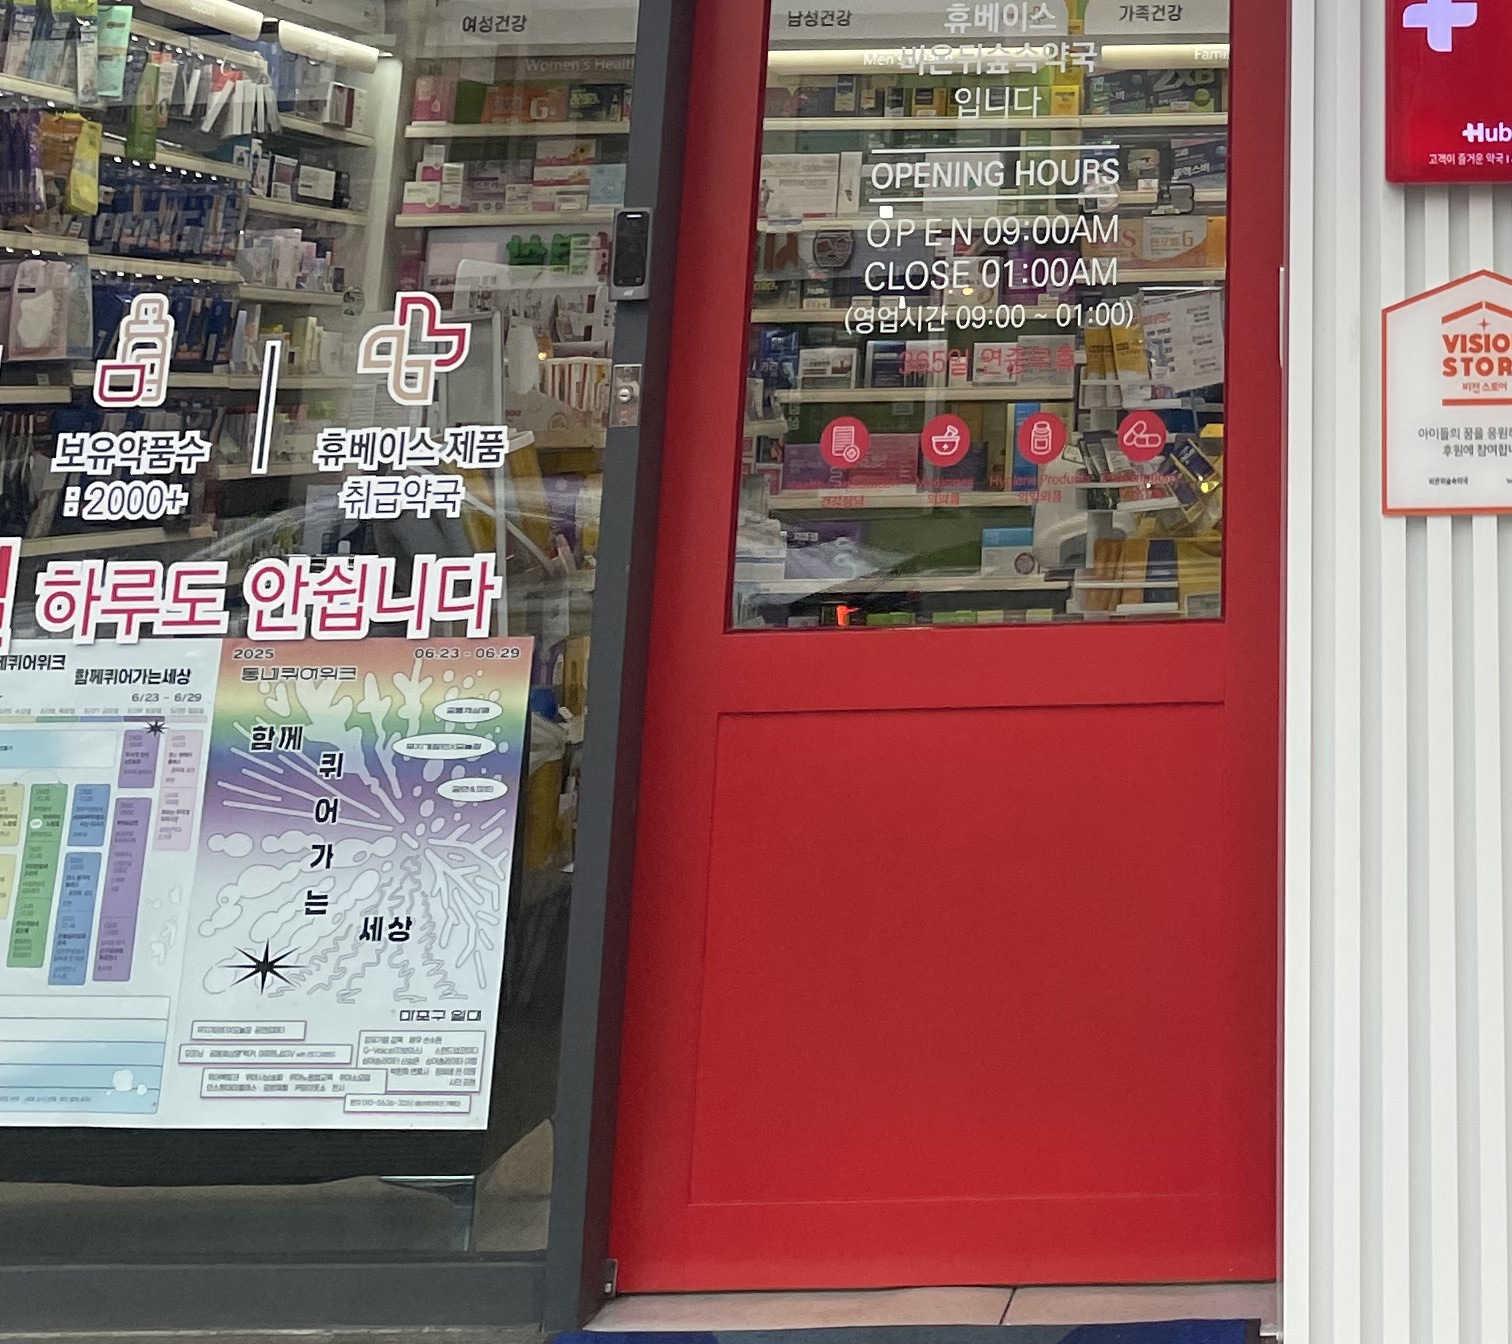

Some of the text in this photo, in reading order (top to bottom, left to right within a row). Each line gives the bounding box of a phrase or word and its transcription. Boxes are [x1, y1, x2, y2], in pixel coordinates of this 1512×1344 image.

[462, 15, 527, 33] 여성건강
[787, 10, 853, 27] 남성건강
[944, 2, 1057, 34] 휴베이스
[1119, 4, 1183, 23] 가족건강
[900, 41, 1098, 76] 비온뒤숲속약국
[954, 86, 1042, 120] 입니다
[871, 158, 1120, 190] OPENING HOURS
[866, 214, 1118, 248] OPEN 09:00AM
[864, 257, 1118, 291] CLOSE 01:00AM
[844, 305, 948, 334] (영업시간
[956, 305, 1025, 330] 09:00
[1056, 301, 1134, 329] 01:00)
[318, 429, 505, 466] 휴베이스 제품
[1418, 427, 1461, 440] 아이들의
[54, 433, 210, 472] 보유약품수
[1443, 444, 1474, 457] 후원에
[343, 479, 462, 516] 취급약국
[42, 561, 223, 637] 하루도
[249, 556, 498, 635] 안쉽니다
[233, 647, 520, 659] 2025 06.23 06.29
[74, 668, 191, 686] 함께퀴어가는세상
[131, 693, 202, 702] 6/23 6/29
[250, 725, 303, 751] 함께
[358, 916, 413, 942] 세상
